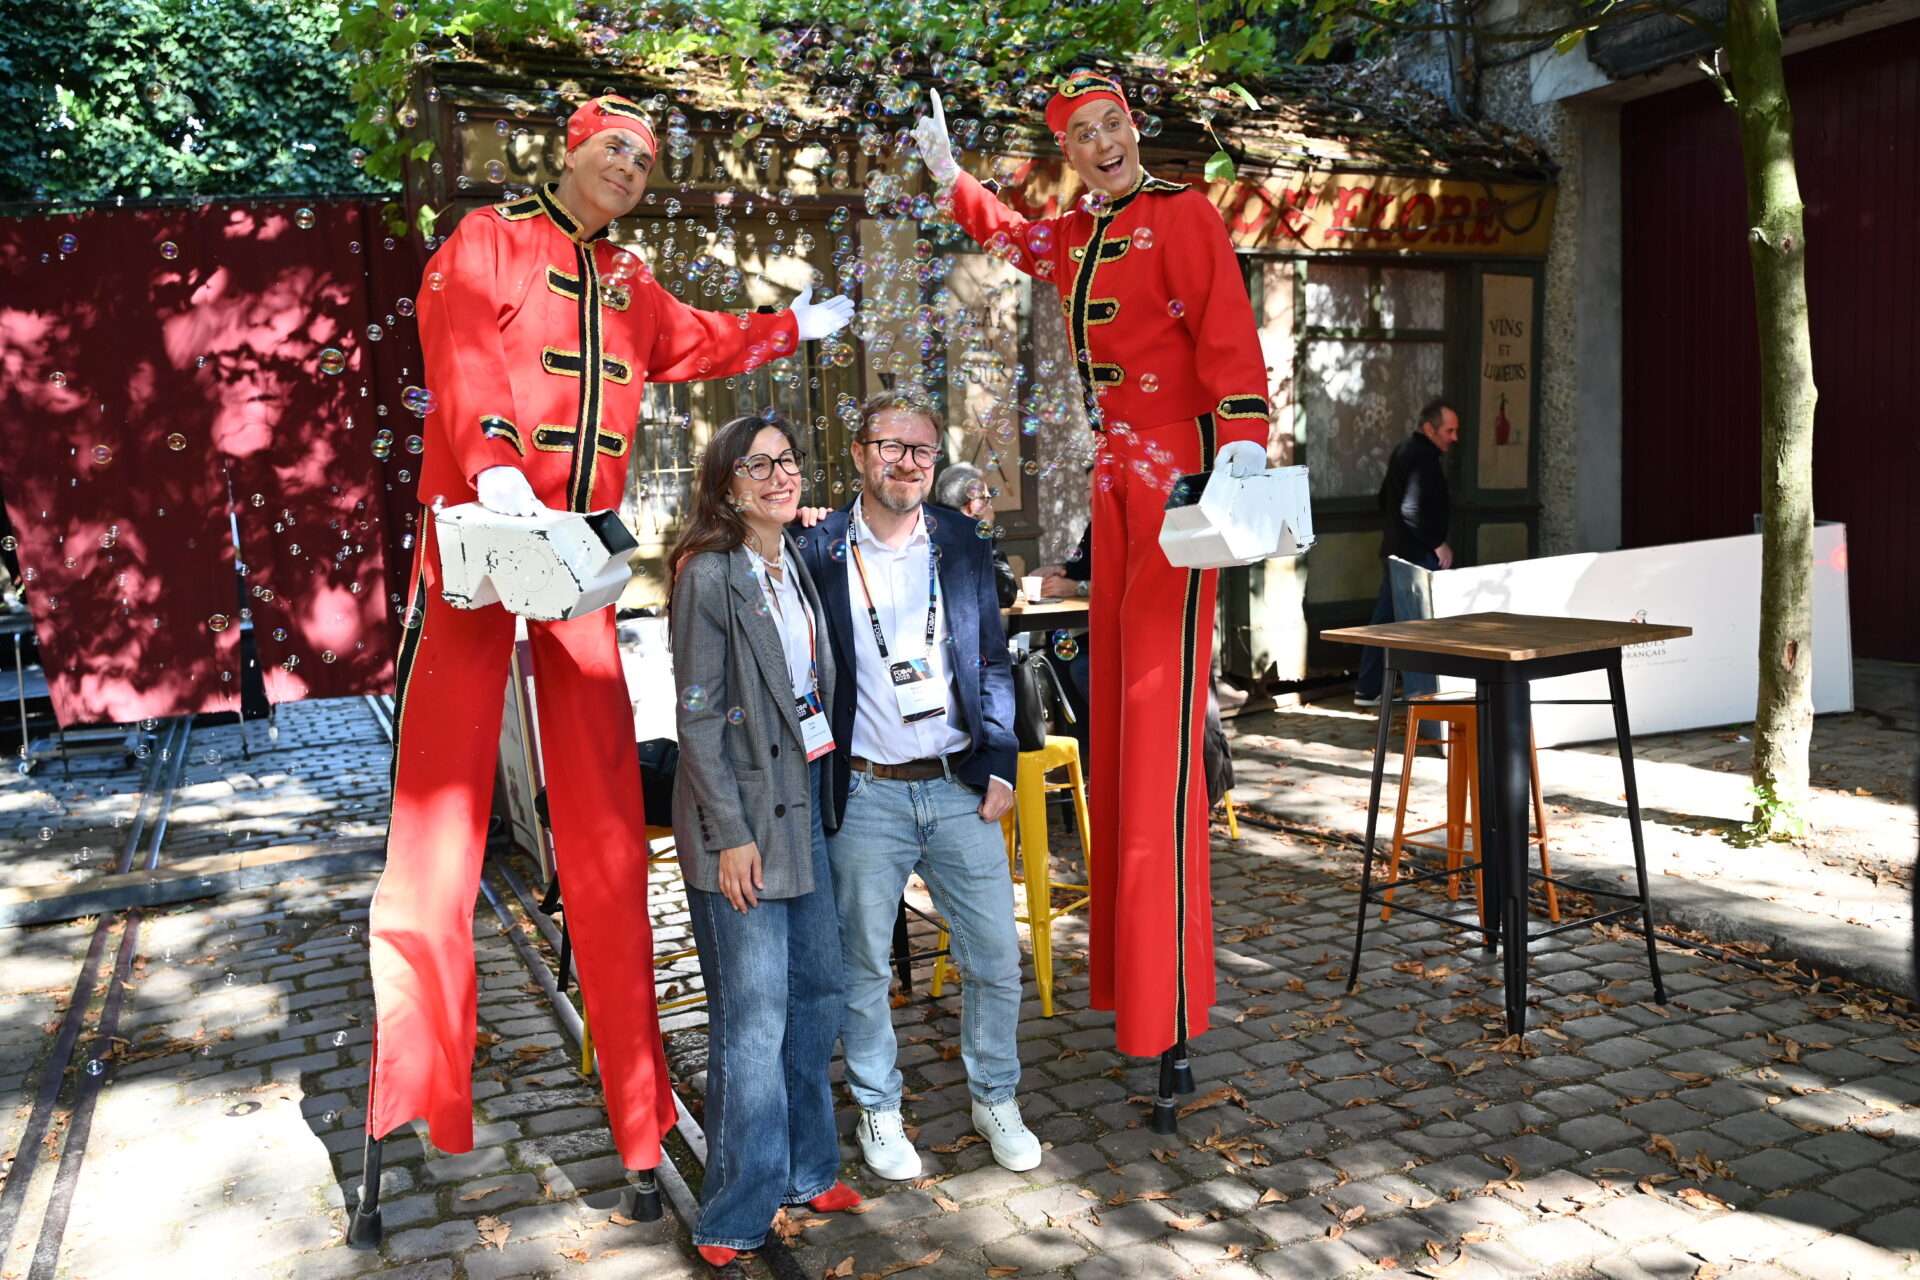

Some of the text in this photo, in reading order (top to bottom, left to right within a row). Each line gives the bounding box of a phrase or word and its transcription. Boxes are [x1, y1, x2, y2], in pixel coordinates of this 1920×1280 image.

[1325, 185, 1505, 246] FLORE
[1488, 319, 1523, 337] VINS
[1498, 343, 1512, 358] ET
